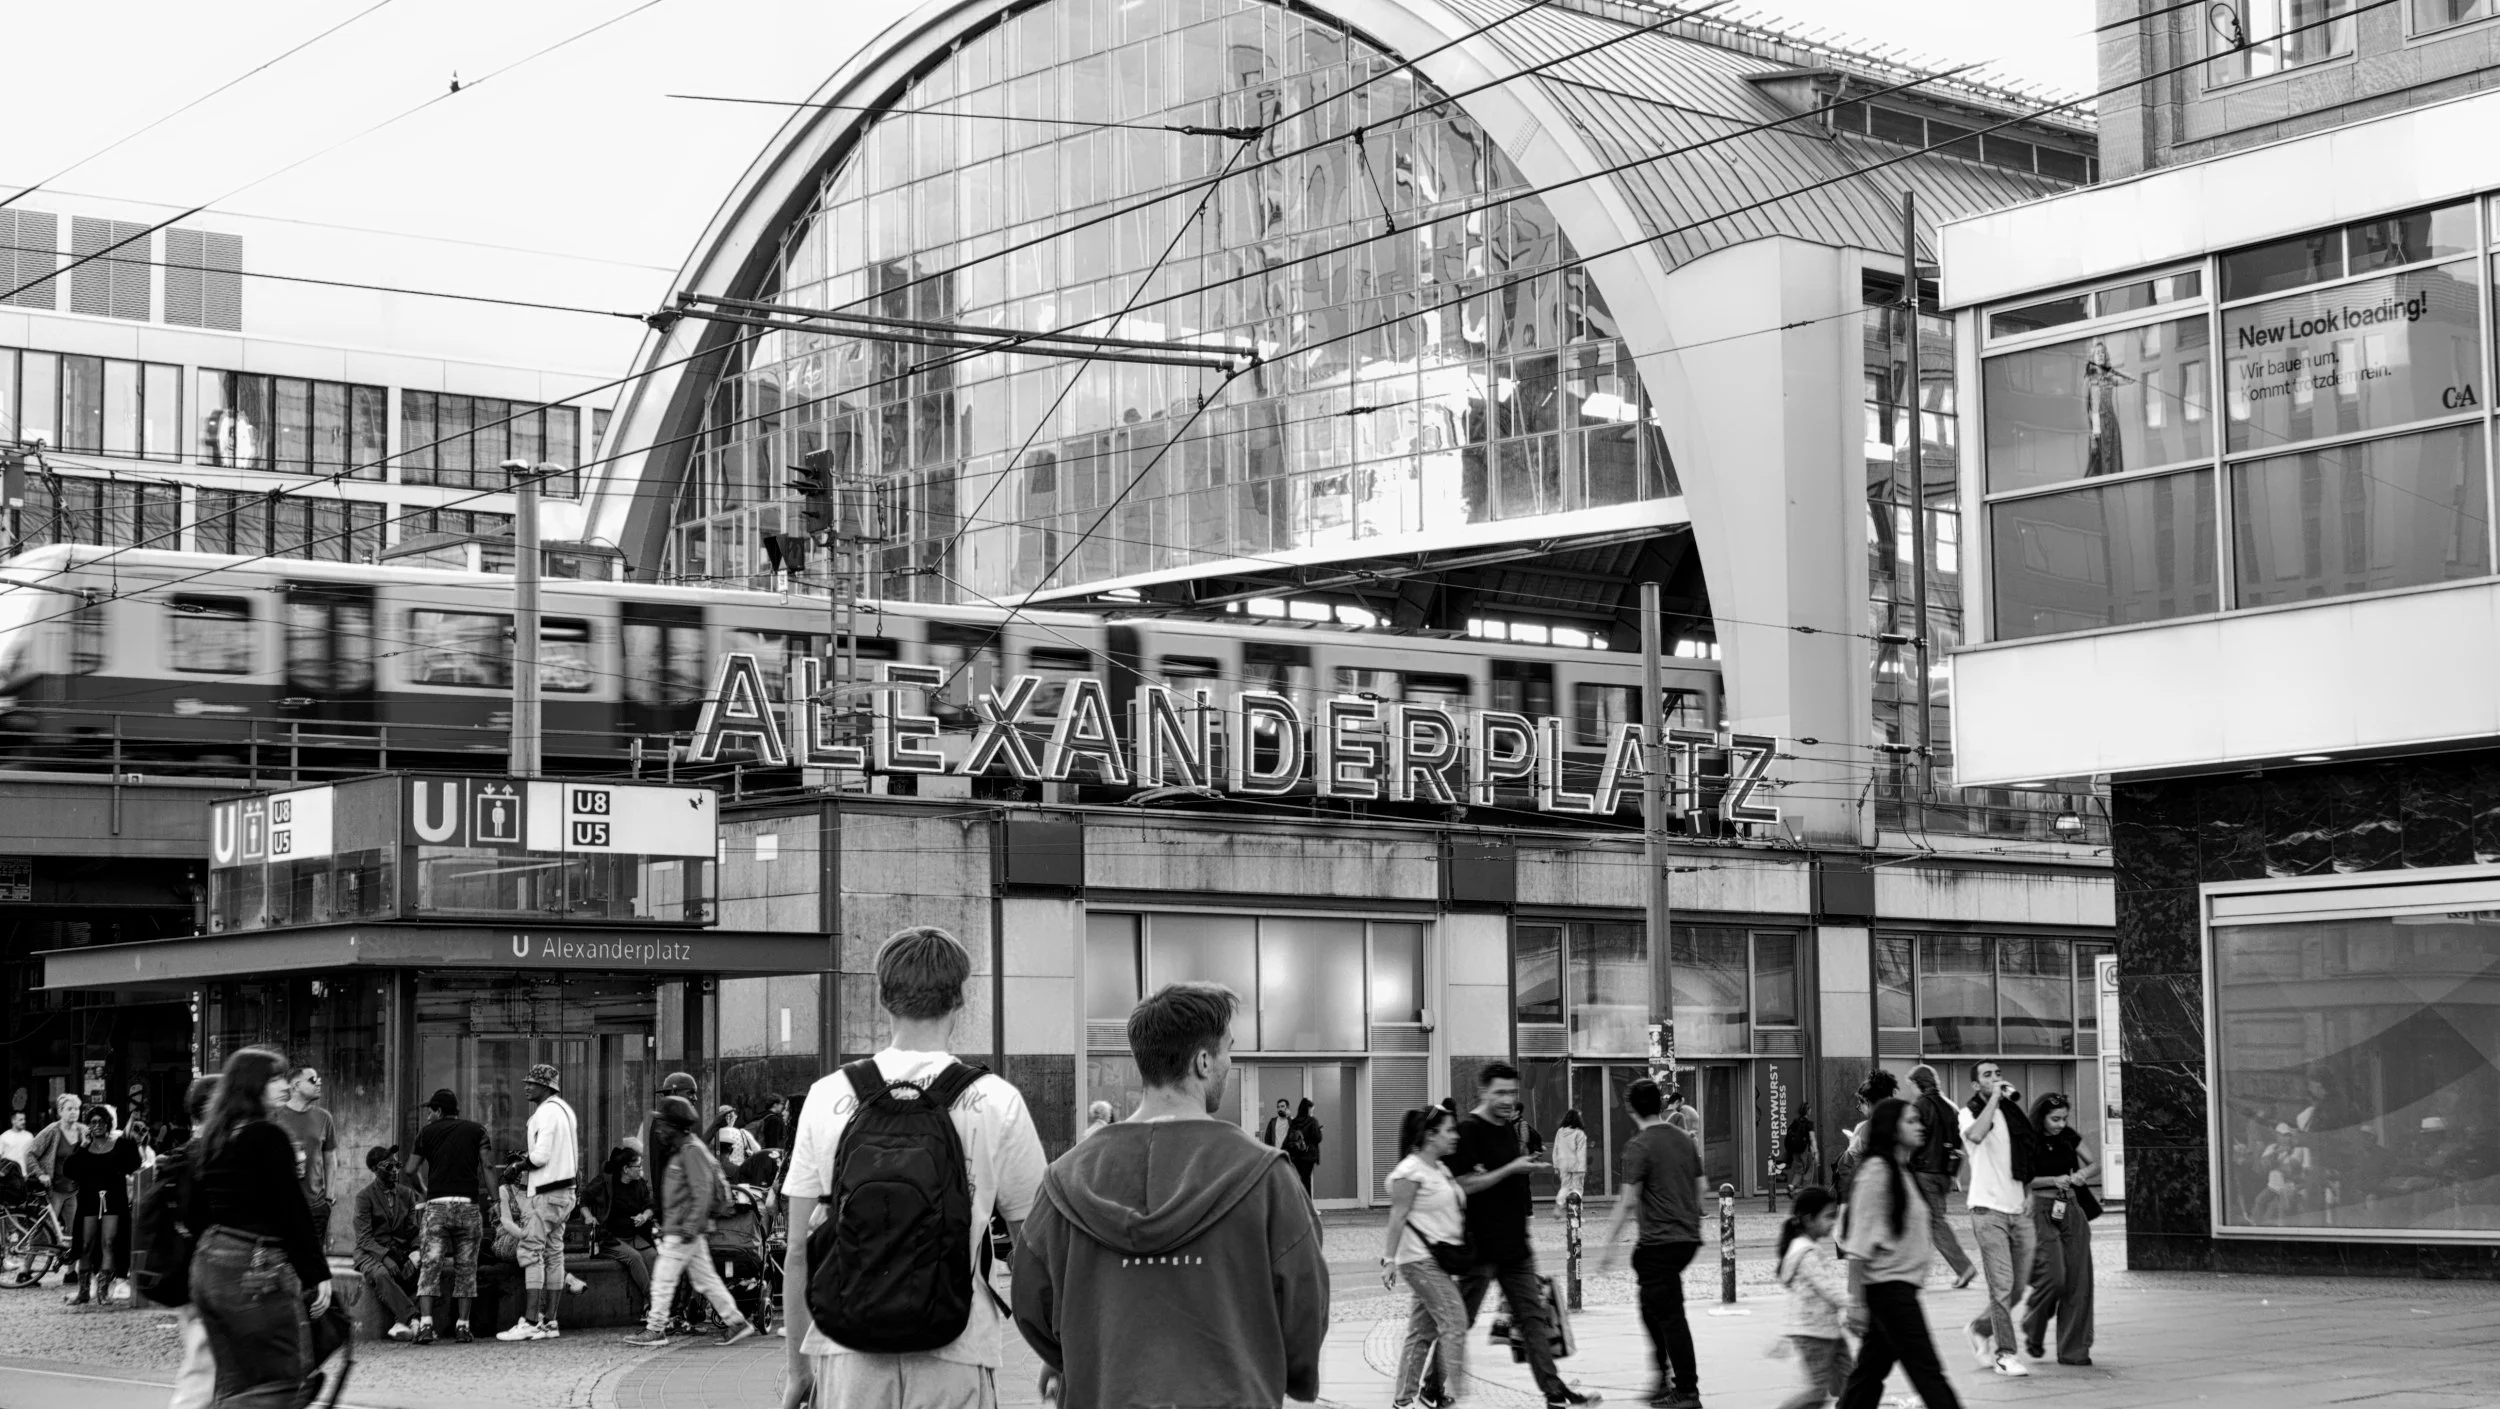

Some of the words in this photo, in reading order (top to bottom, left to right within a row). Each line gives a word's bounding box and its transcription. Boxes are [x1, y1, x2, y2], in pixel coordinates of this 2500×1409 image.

[2238, 324, 2285, 350] New
[2289, 309, 2338, 340] Look
[2343, 290, 2428, 330] loading!
[2240, 359, 2264, 380] Wir
[2267, 355, 2311, 376] bauen
[2313, 350, 2340, 367] um.
[2240, 380, 2290, 403] Kommt
[2292, 369, 2357, 393] trotzdem
[2360, 363, 2392, 381] rein.
[2441, 384, 2478, 409] C&A
[685, 652, 1782, 825] ALEXANDERPLATZ
[274, 801, 290, 822] U8
[413, 781, 457, 843] U
[577, 793, 607, 813] U8
[215, 805, 236, 864] U
[274, 832, 290, 853] U5
[577, 824, 607, 844] U5
[512, 935, 529, 957] U
[542, 937, 691, 964] Alexanderplatz
[1769, 1064, 1780, 1157] CURRYWURST
[1779, 1085, 1787, 1136] EXPRESS
